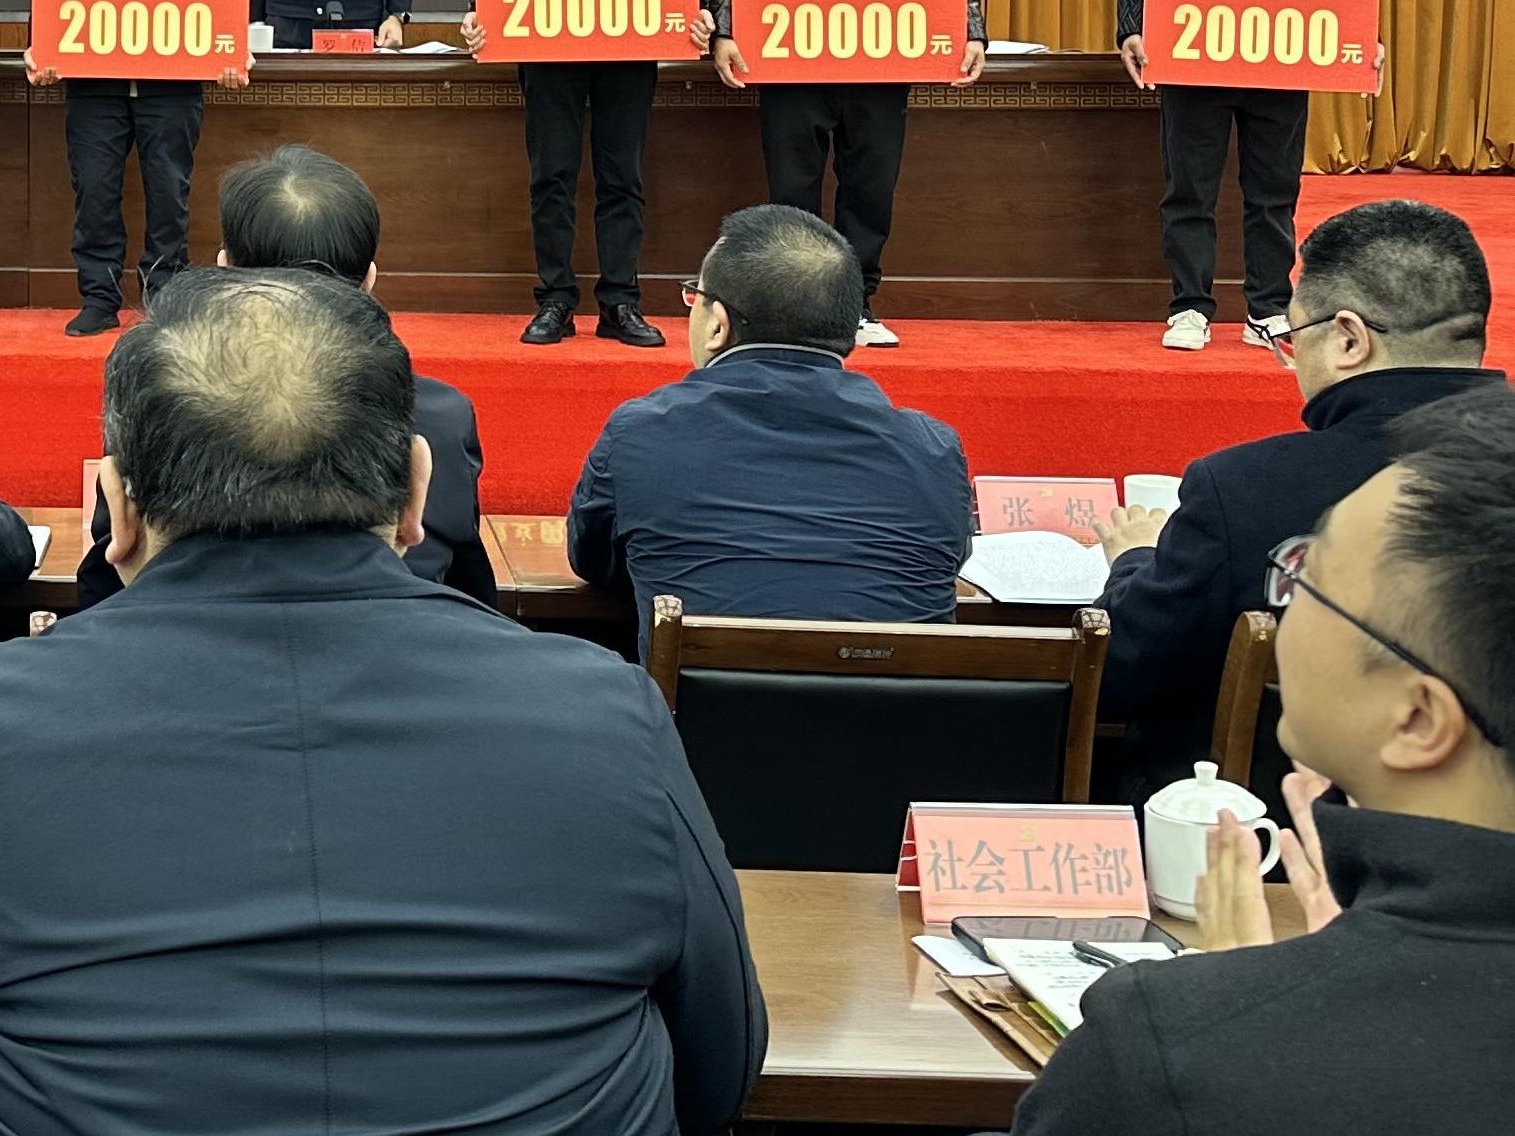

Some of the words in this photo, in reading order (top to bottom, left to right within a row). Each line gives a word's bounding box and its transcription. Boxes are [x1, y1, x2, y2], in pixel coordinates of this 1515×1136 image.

[924, 839, 1133, 896] 社会工作部
